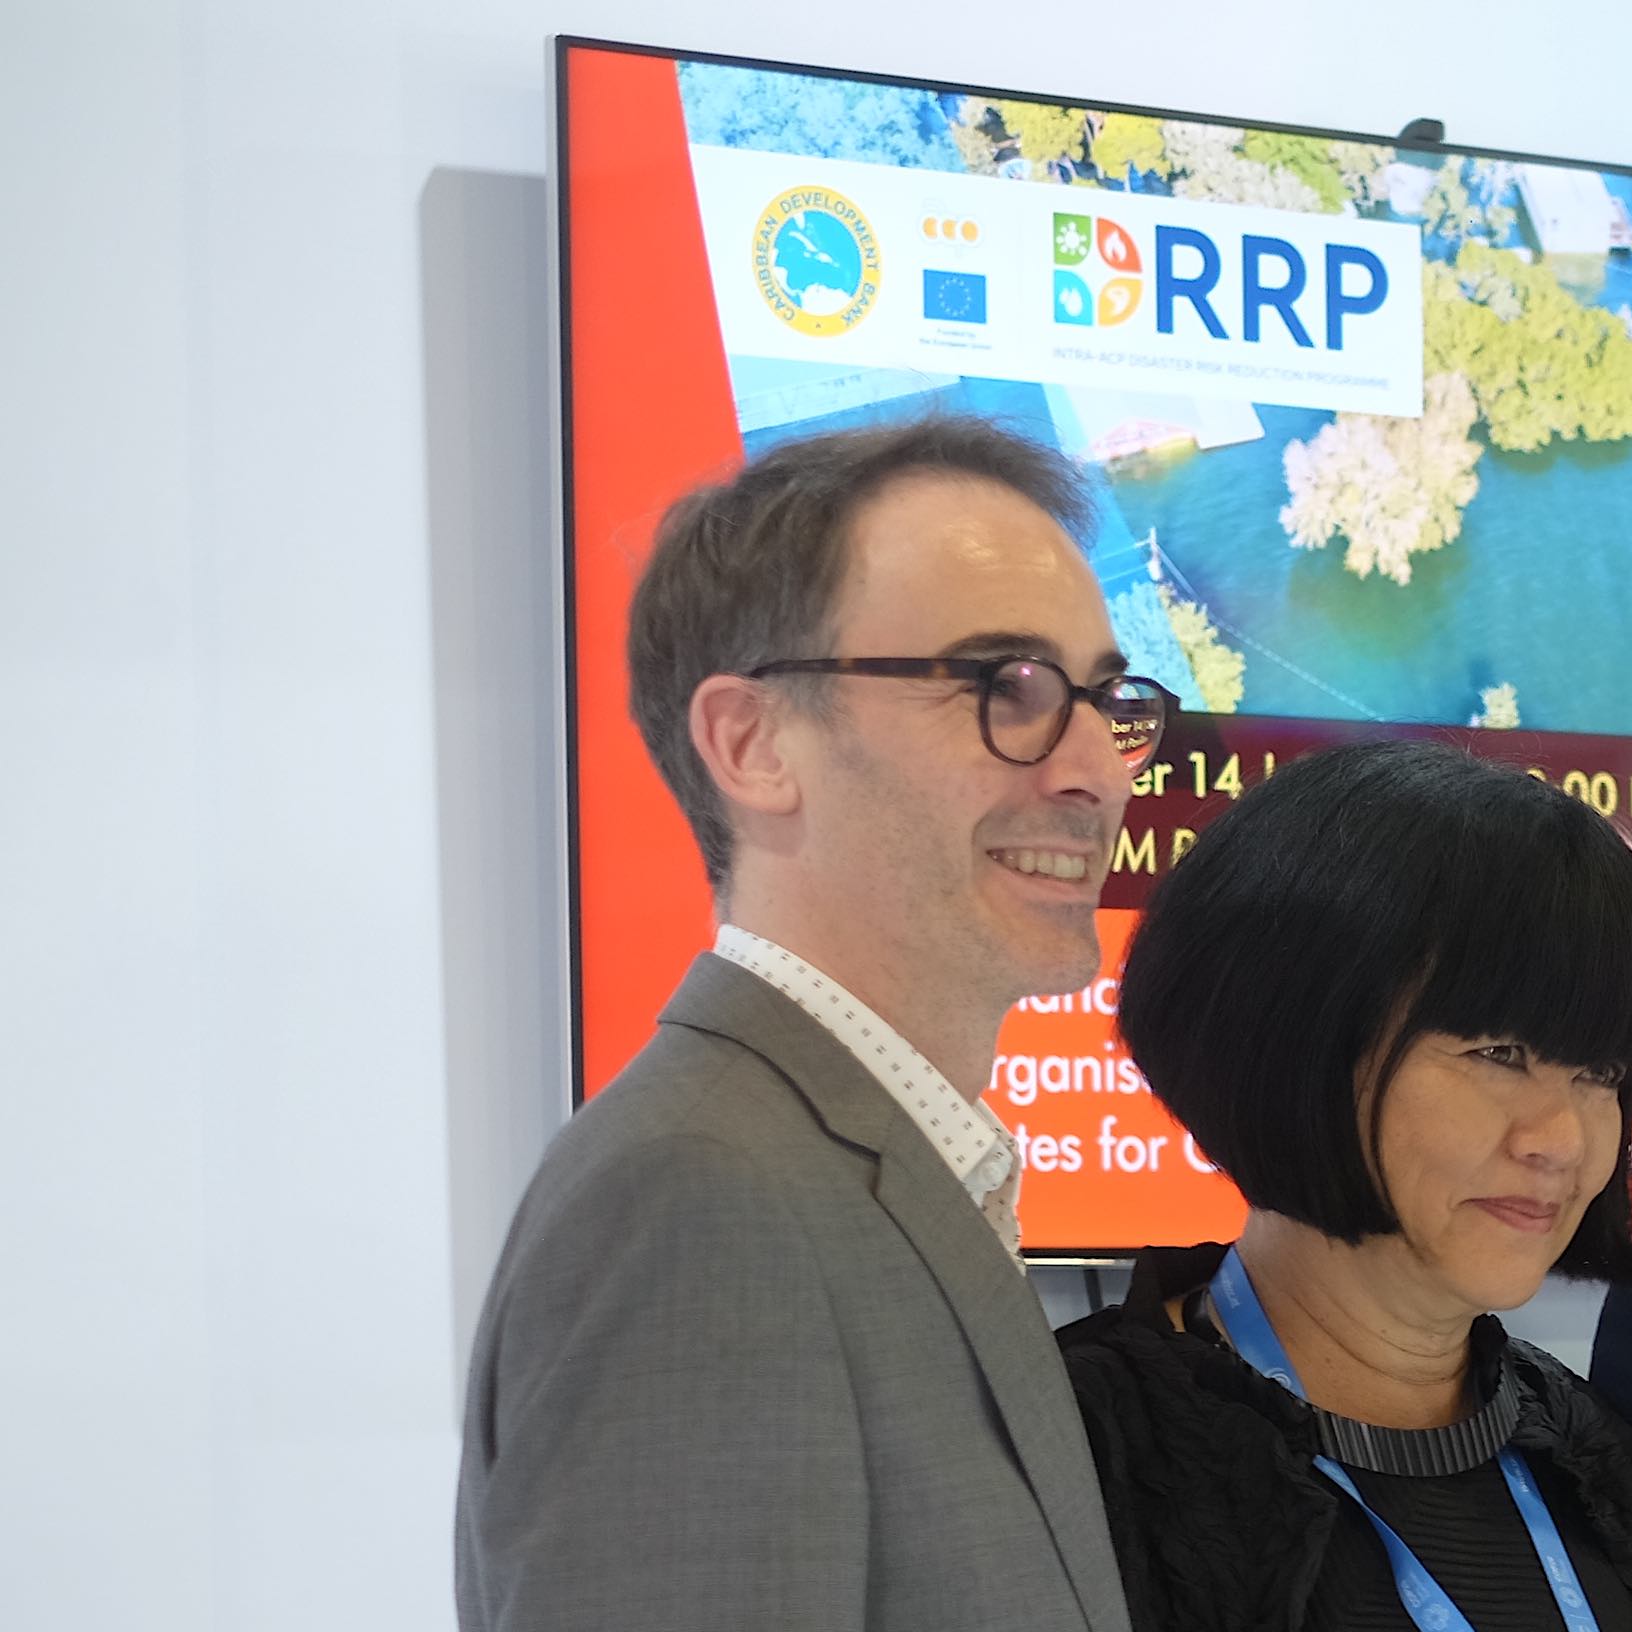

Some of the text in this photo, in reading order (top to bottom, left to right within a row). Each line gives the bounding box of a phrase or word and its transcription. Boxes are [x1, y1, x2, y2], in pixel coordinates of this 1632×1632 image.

[756, 216, 795, 322] CARIBBEAN
[780, 192, 879, 271] DEVELOPMENT
[1188, 751, 1244, 800] 14
[989, 1041, 1154, 1107] rganis
[1097, 1114, 1169, 1173] for
